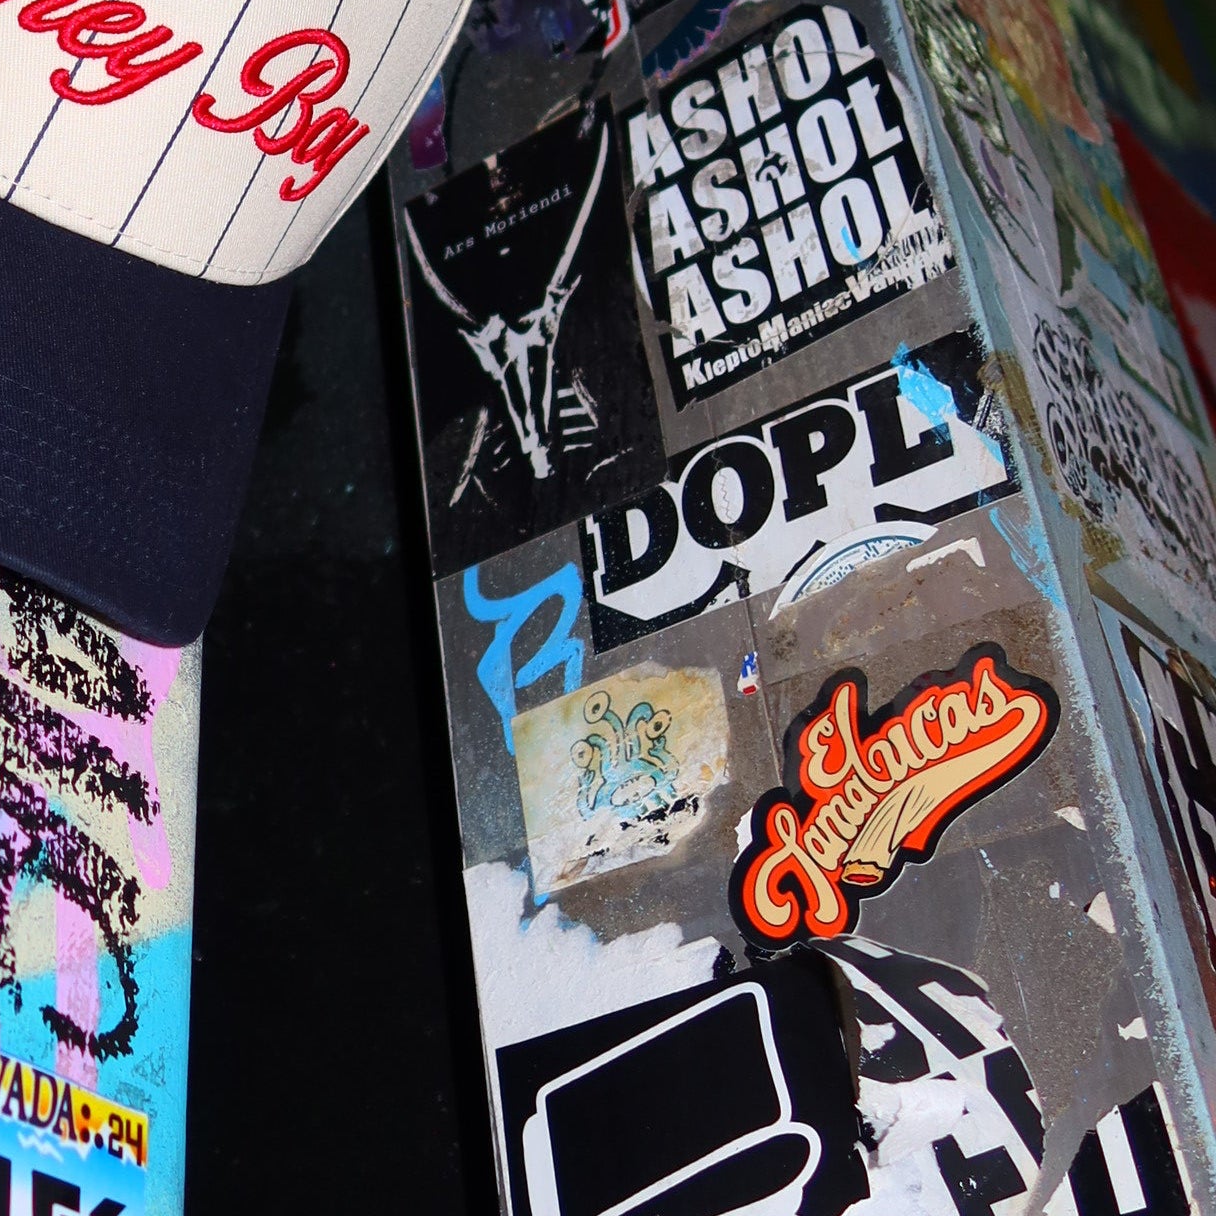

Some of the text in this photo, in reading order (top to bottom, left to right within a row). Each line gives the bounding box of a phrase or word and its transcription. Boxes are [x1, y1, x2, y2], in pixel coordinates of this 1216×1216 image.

[628, 5, 876, 187] ASHOL
[648, 76, 903, 273] ASHOL
[444, 183, 573, 261] Ars Moriendi
[667, 155, 936, 359] ASHOL
